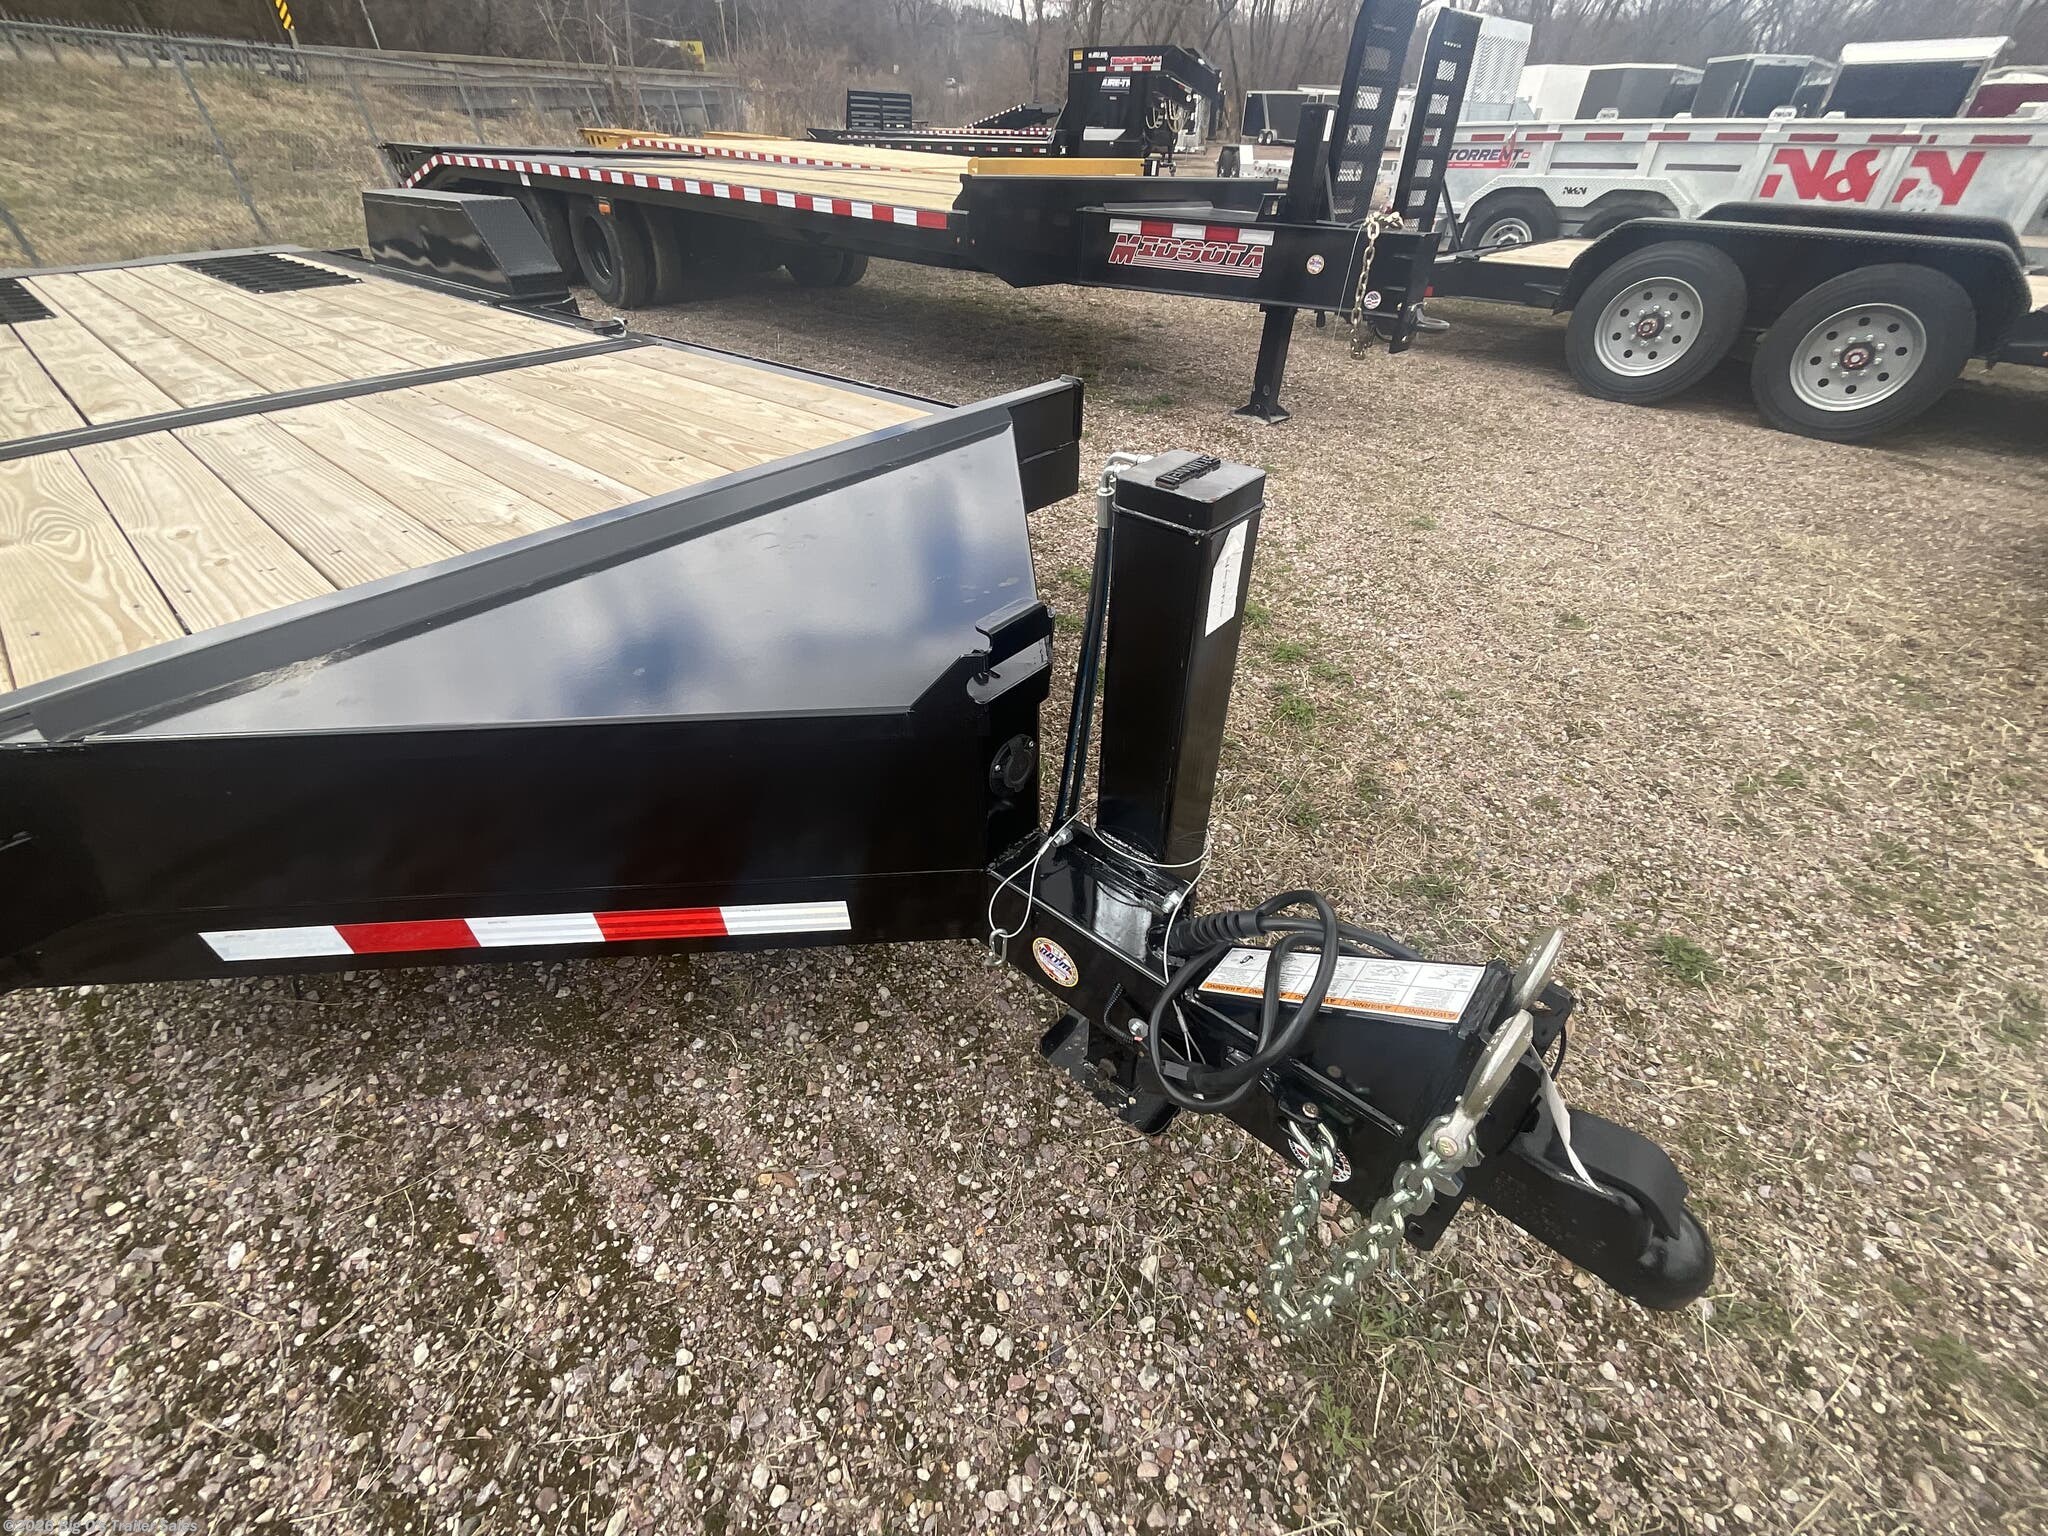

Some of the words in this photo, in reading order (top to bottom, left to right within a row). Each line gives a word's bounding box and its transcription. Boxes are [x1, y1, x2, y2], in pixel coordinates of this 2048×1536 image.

[1449, 148, 1524, 161] TORRENT
[1108, 233, 1266, 269] MIDSOTA
[1345, 1000, 1385, 1010] WARNING
[1403, 1006, 1449, 1019] WARNING
